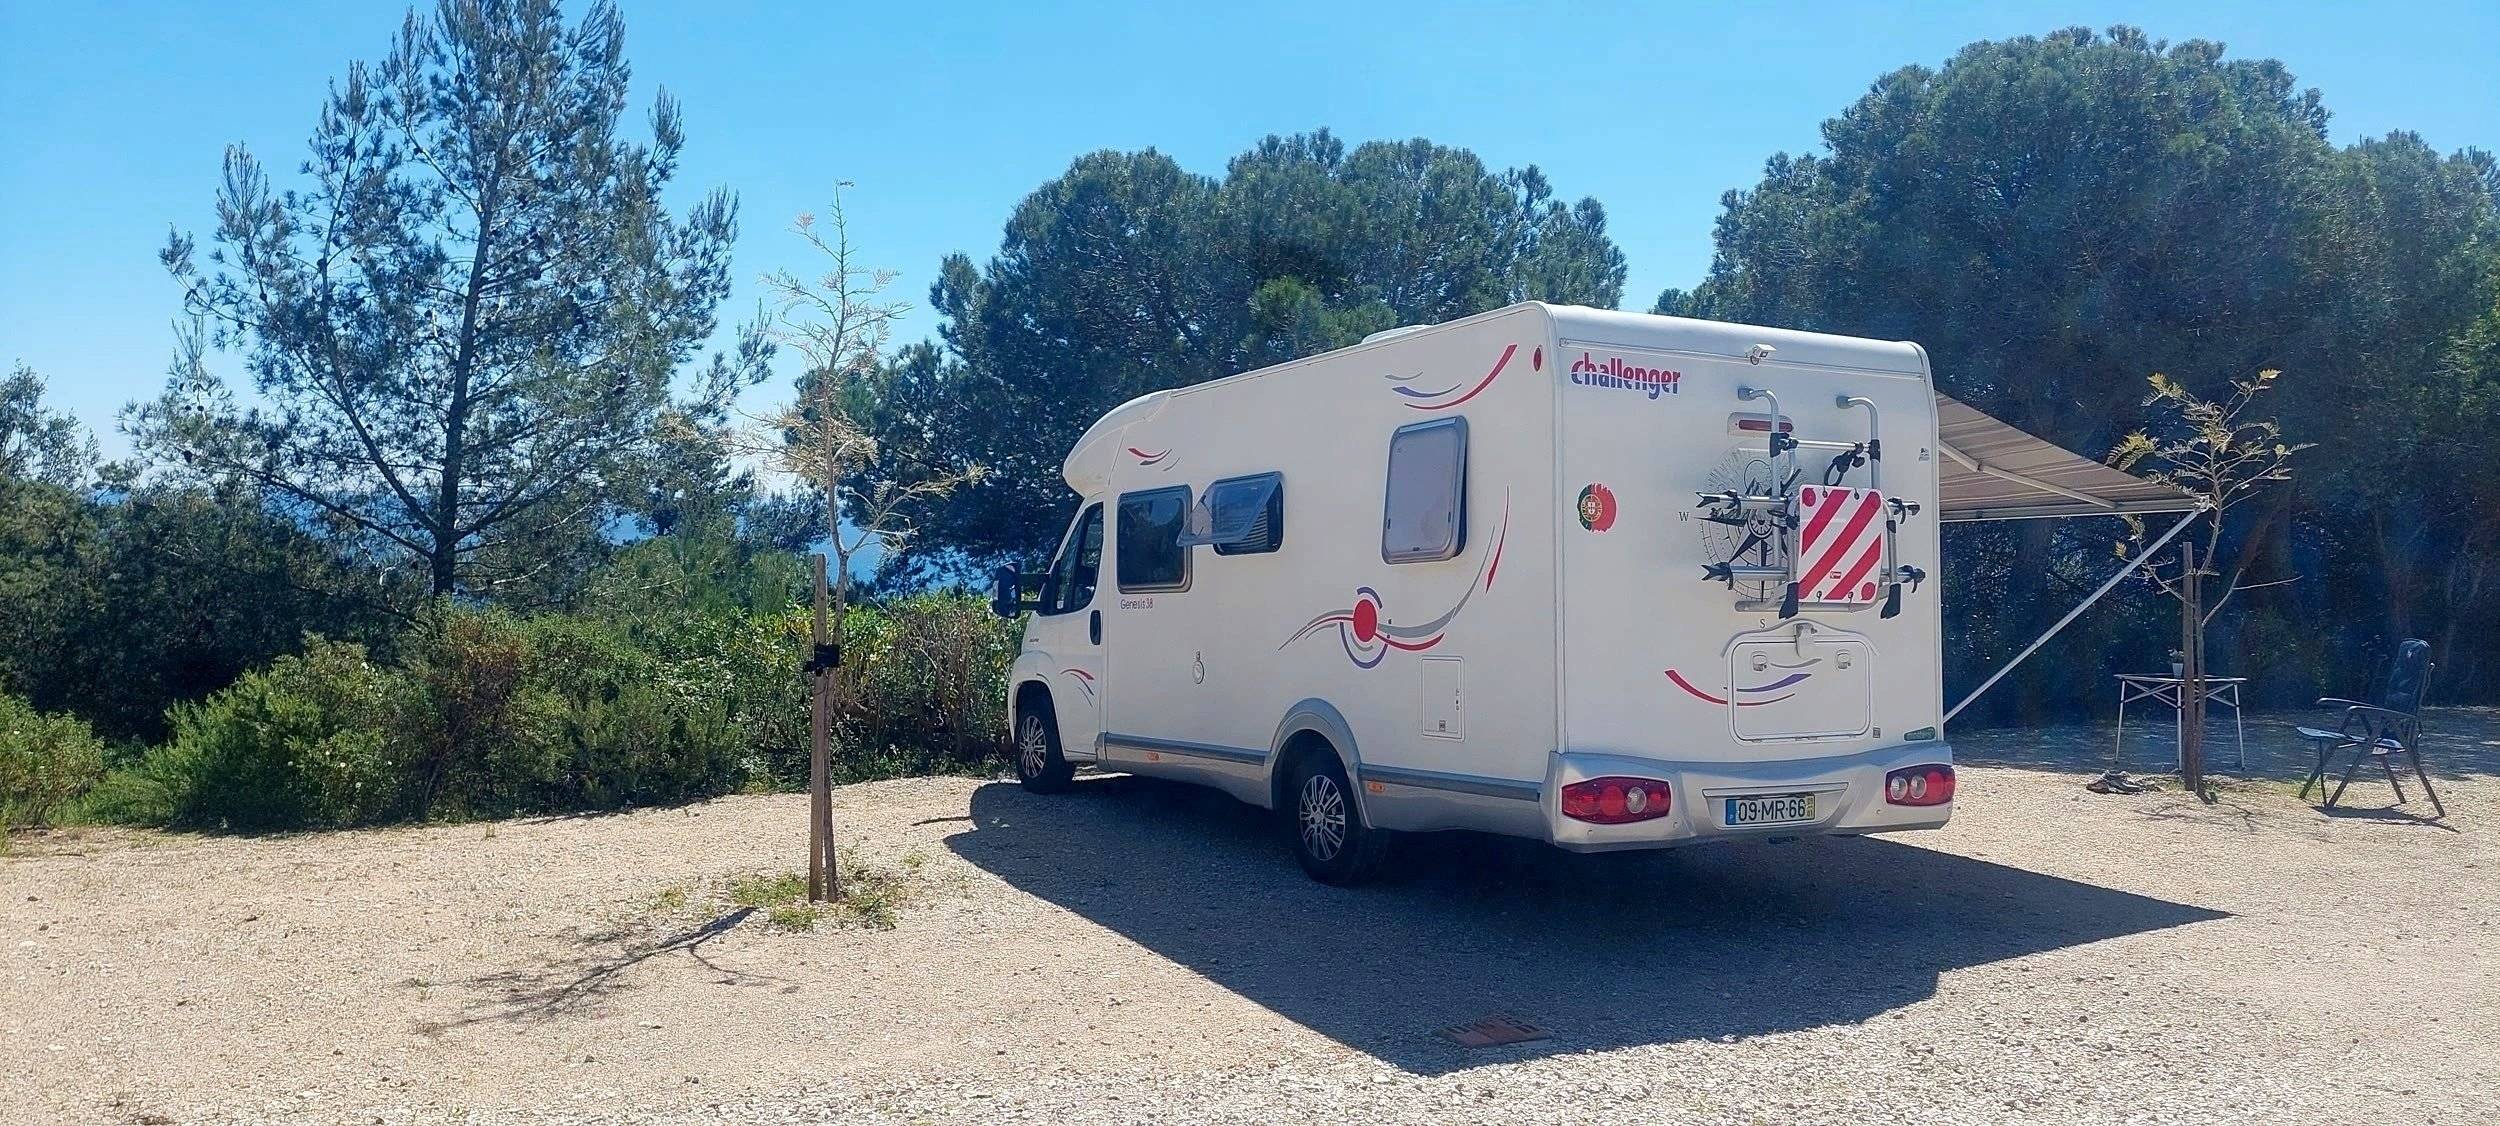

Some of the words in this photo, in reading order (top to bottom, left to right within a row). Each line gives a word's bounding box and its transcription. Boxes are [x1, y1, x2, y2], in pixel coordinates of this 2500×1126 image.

[1571, 352, 1680, 400] challenger
[1678, 511, 1689, 521] W
[1759, 618, 1765, 629] S
